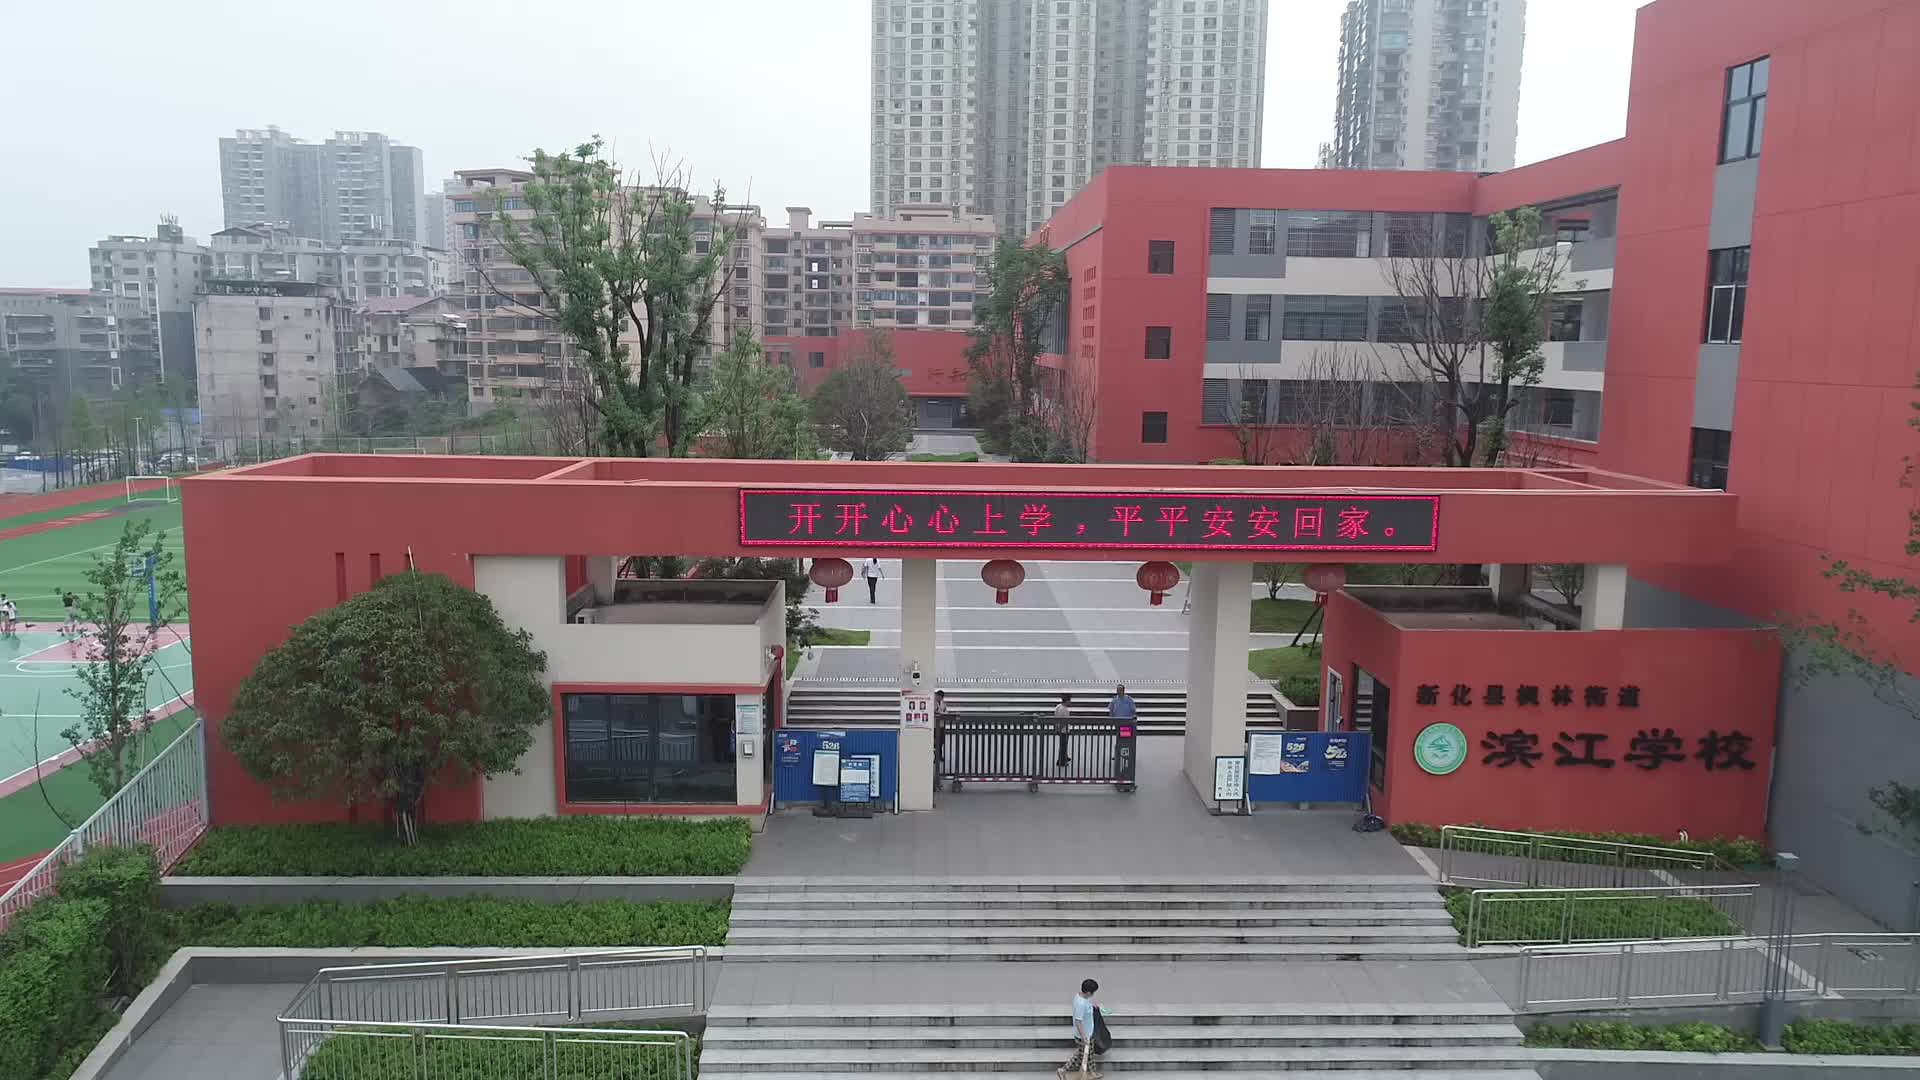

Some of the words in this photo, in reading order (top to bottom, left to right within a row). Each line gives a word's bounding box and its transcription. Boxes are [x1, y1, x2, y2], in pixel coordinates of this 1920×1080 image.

[788, 502, 1399, 539] 开开心心上学，平平安安回家。
[1480, 728, 1756, 771] 滨江学校
